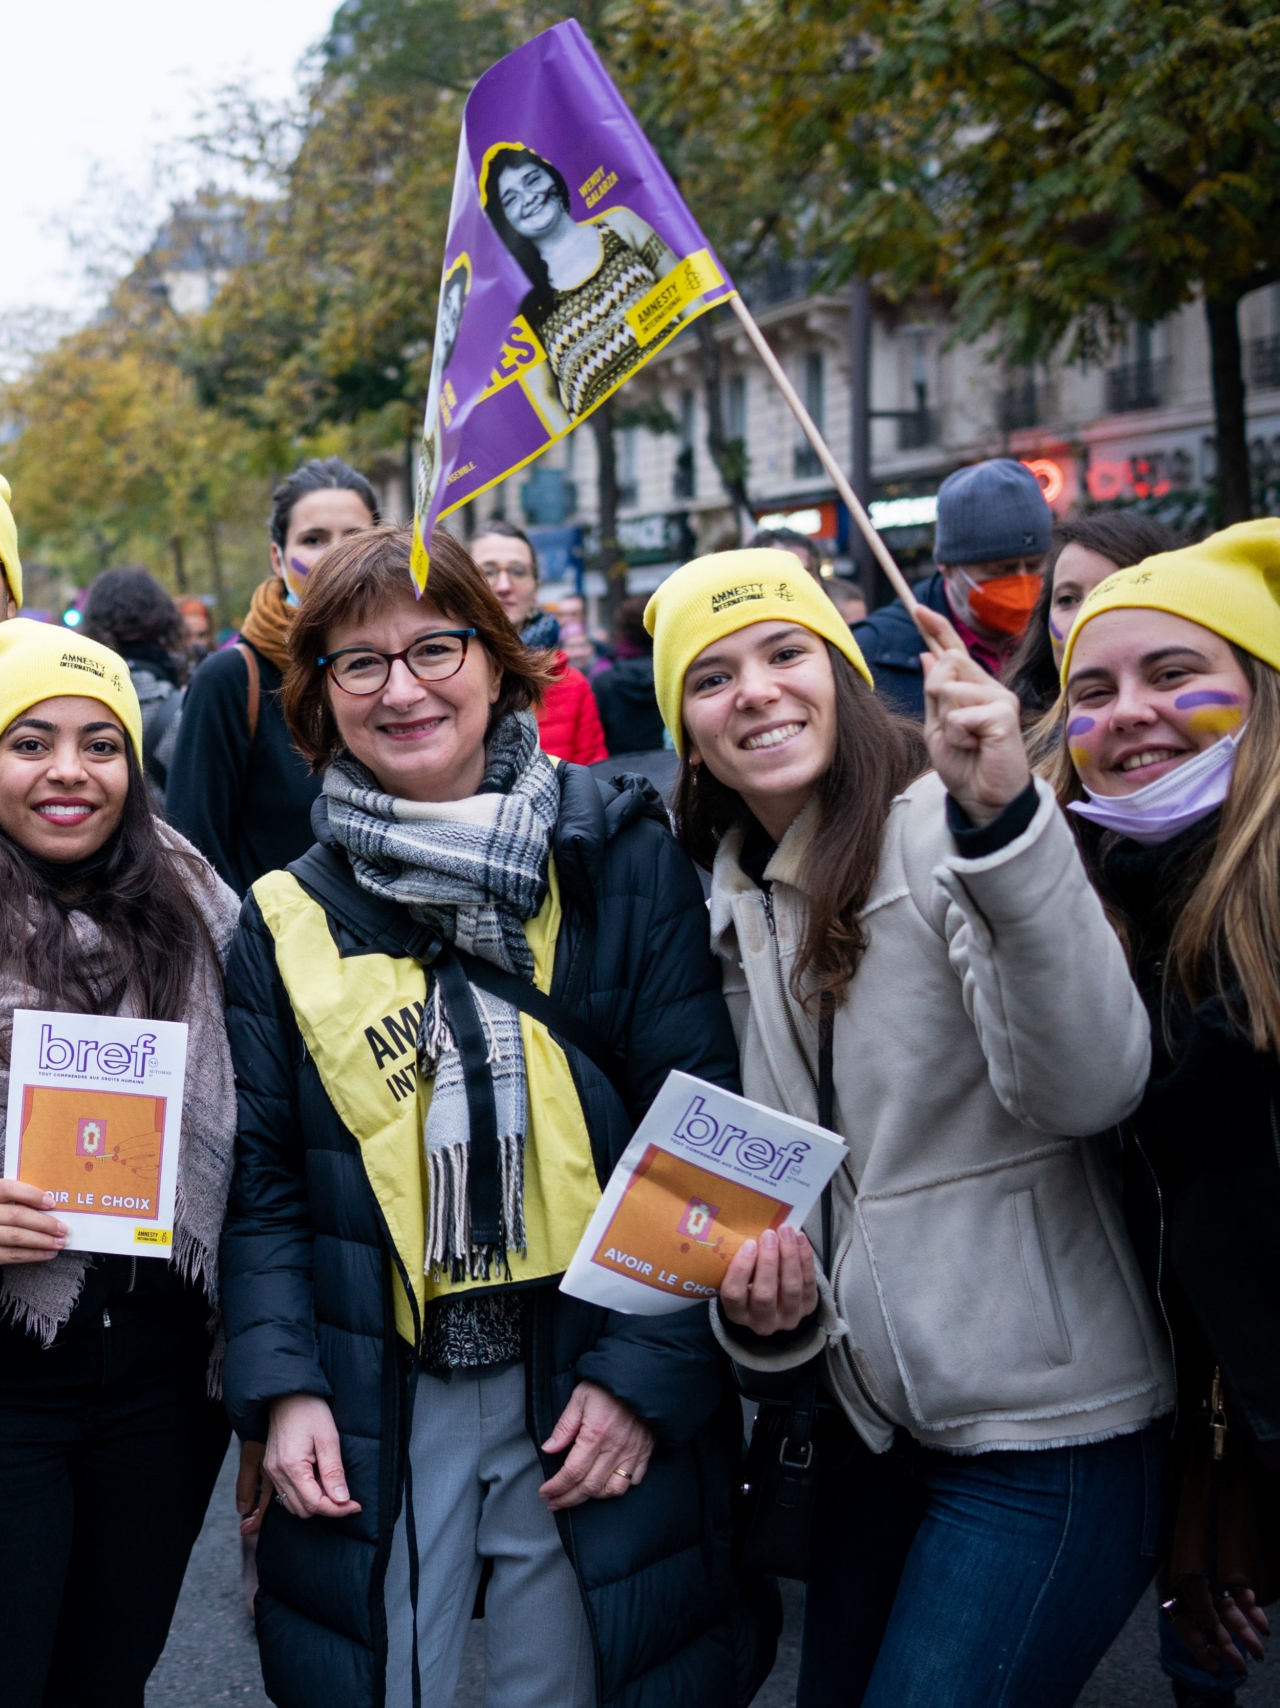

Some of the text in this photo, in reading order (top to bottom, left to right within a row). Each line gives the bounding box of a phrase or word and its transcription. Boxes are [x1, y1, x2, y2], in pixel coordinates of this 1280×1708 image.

[578, 165, 605, 198] WENDY
[585, 171, 619, 209] GALARZA
[637, 281, 679, 325] AMNESTY
[641, 295, 683, 334] INTERNATIONAL
[485, 326, 536, 389] ES
[711, 583, 763, 605] AMNESTY
[712, 592, 765, 614] INTERNATIONAL
[60, 661, 105, 678] INTERNATIONAL
[61, 653, 106, 672] AMNESTY
[39, 1024, 157, 1077] bref
[53, 1072, 87, 1080] COMPRENDRE
[673, 1095, 811, 1181] bref
[77, 1192, 94, 1205] LE
[101, 1195, 150, 1211] CHOIX
[137, 1230, 159, 1238] AMNESTY
[603, 1247, 718, 1296] AVOIR LE CHO
